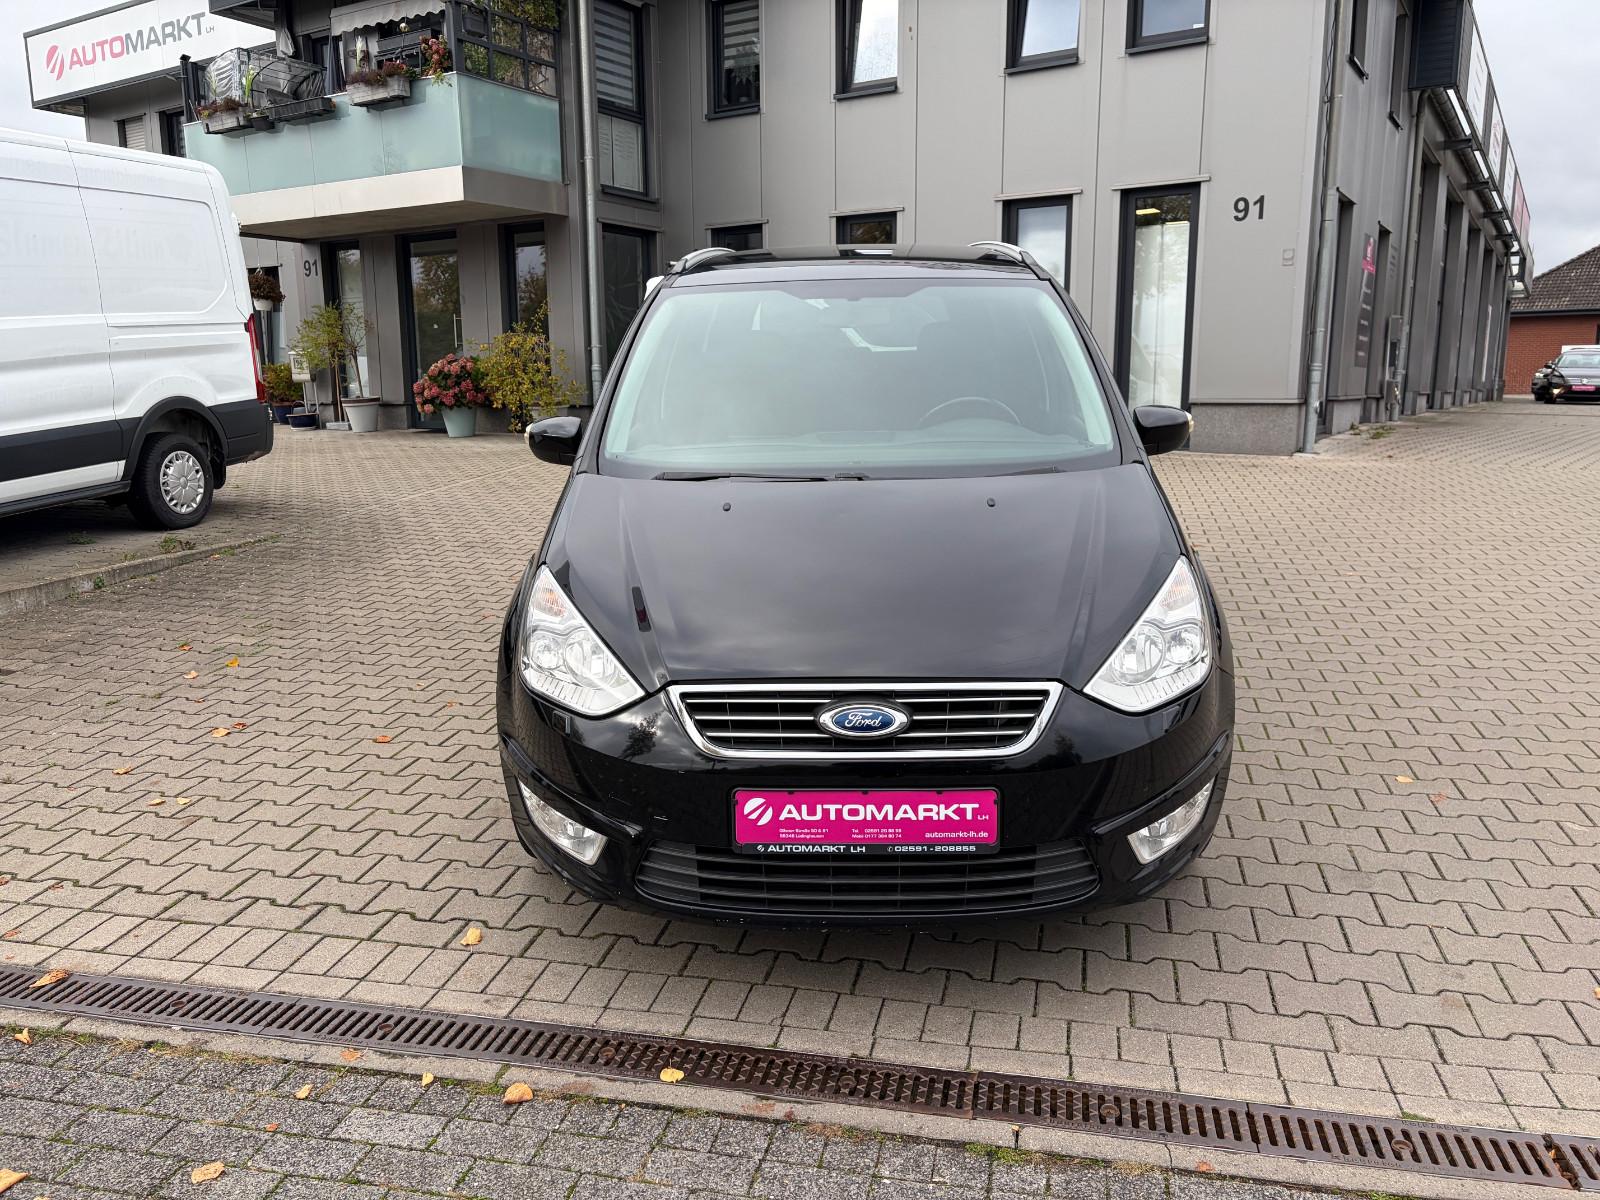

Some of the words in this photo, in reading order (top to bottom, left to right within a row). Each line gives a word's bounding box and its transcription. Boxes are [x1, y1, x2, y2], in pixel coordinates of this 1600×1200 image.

[69, 11, 205, 70] AUTOMARKT
[205, 25, 215, 34] LH
[1233, 194, 1265, 222] 91
[303, 259, 319, 277] 91
[844, 711, 883, 727] Ford
[779, 803, 979, 821] AUTOMARKT
[767, 845, 846, 853] AUTOMARKT
[850, 845, 866, 853] LH
